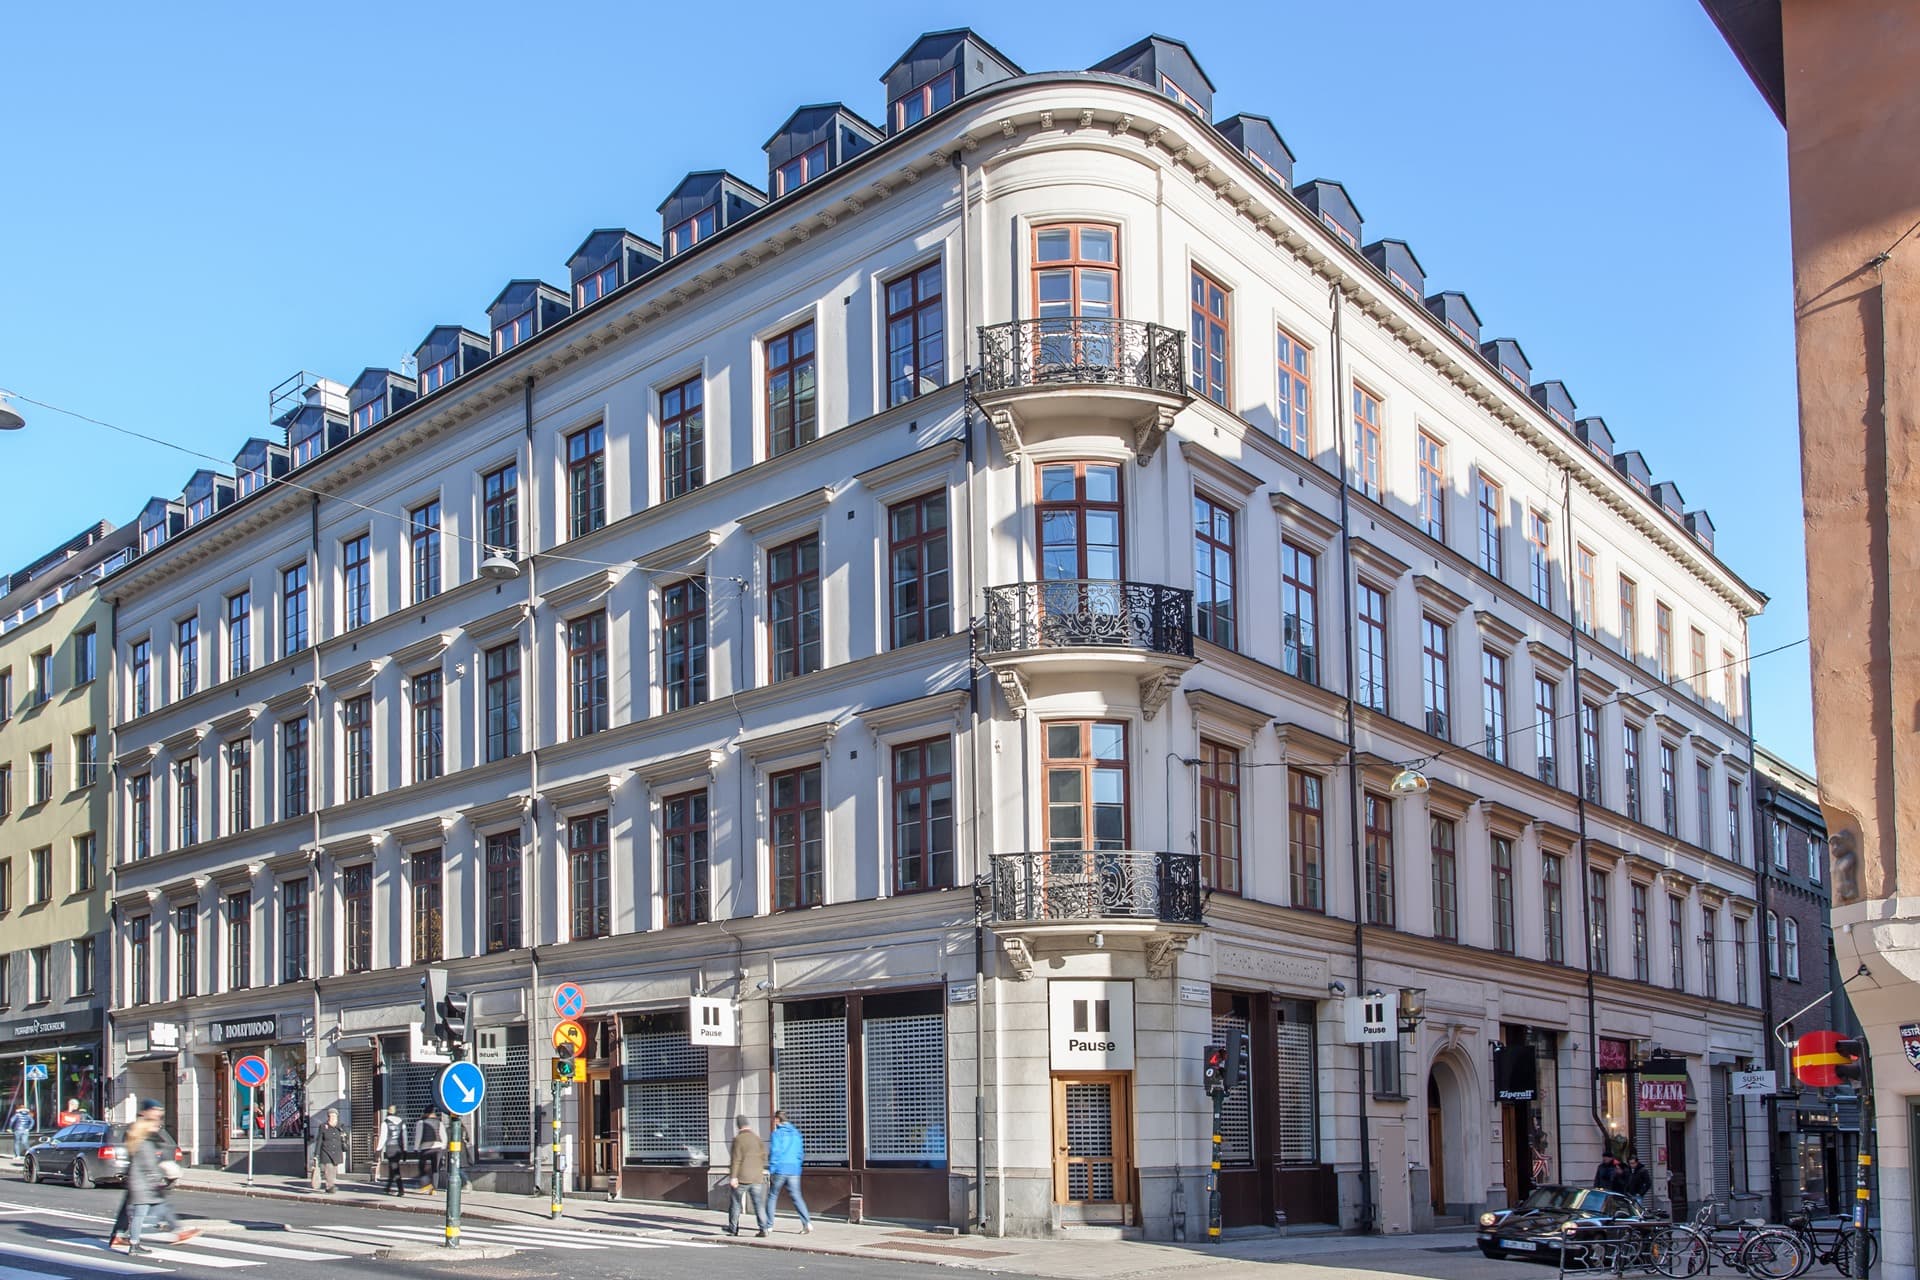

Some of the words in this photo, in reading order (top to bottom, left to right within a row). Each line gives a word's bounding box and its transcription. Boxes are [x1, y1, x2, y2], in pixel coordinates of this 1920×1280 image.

[226, 1021, 274, 1038] HOLLYWOOD
[700, 1029, 722, 1037] Pause
[1363, 1026, 1386, 1034] Pause
[1069, 1039, 1116, 1052] Pause
[1642, 1084, 1683, 1100] OLEANA
